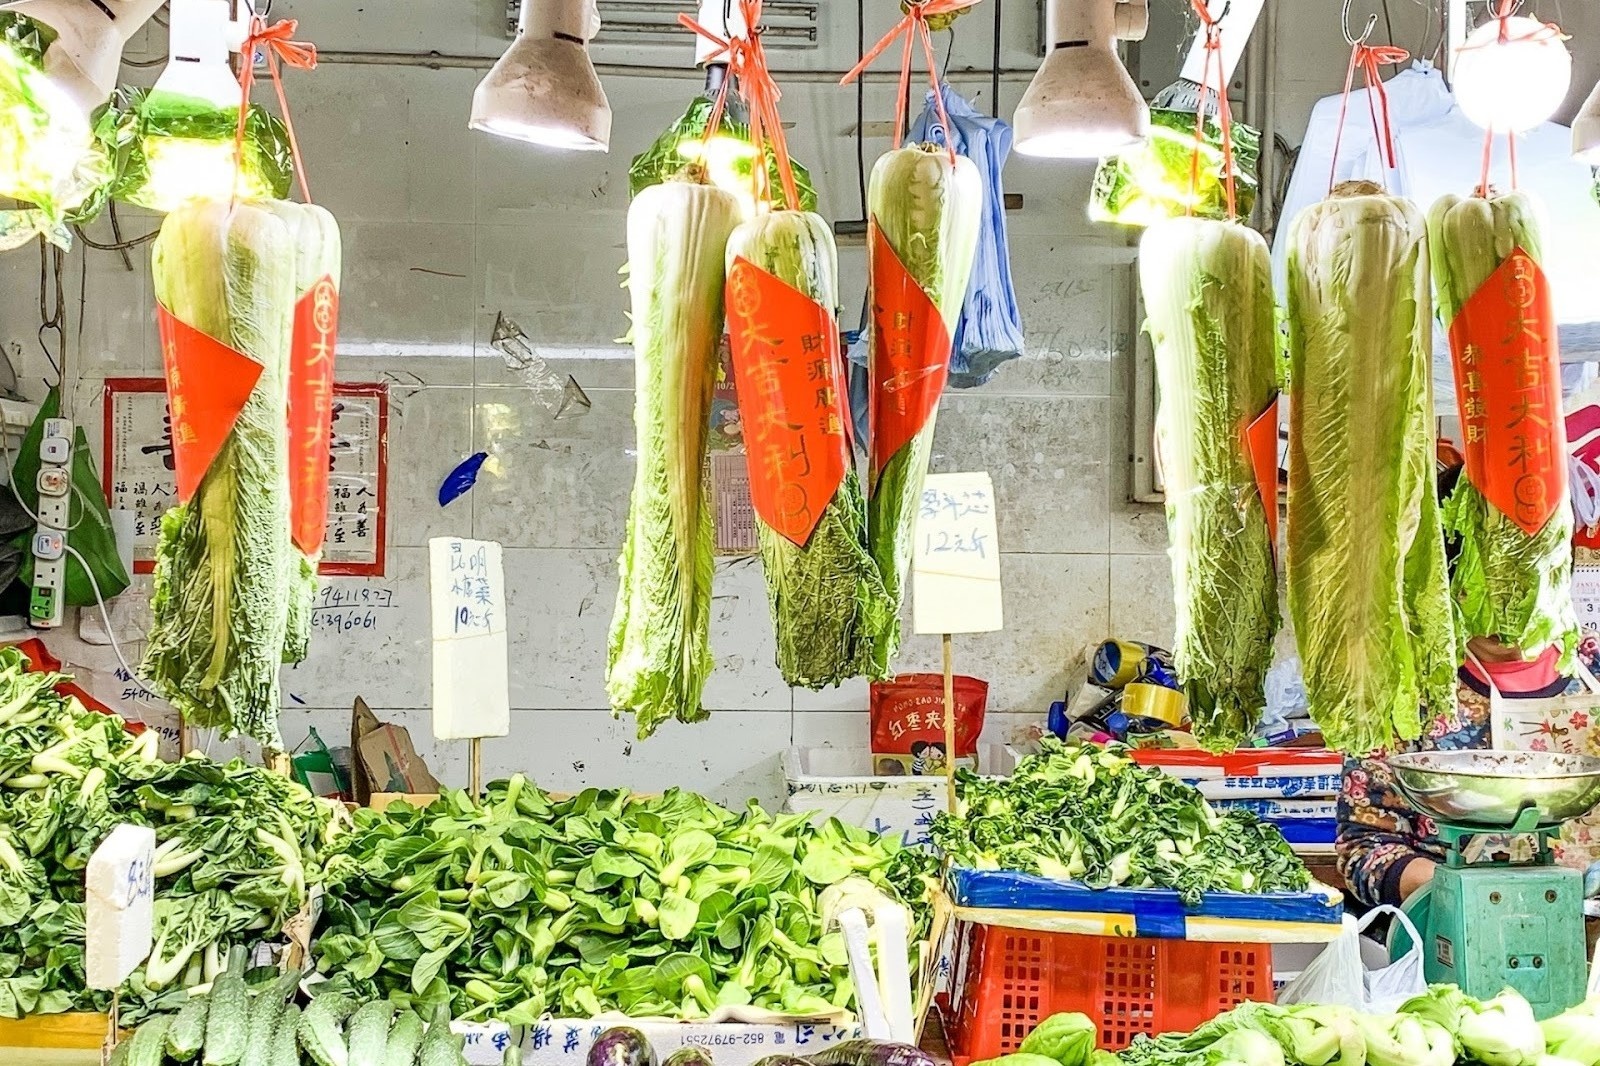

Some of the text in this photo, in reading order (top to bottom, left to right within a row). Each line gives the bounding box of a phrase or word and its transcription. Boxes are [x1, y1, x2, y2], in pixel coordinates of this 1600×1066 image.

[1462, 343, 1489, 446] 恭喜發財
[1502, 311, 1552, 472] 大吉大利
[680, 1032, 764, 1046] 852-97972551
